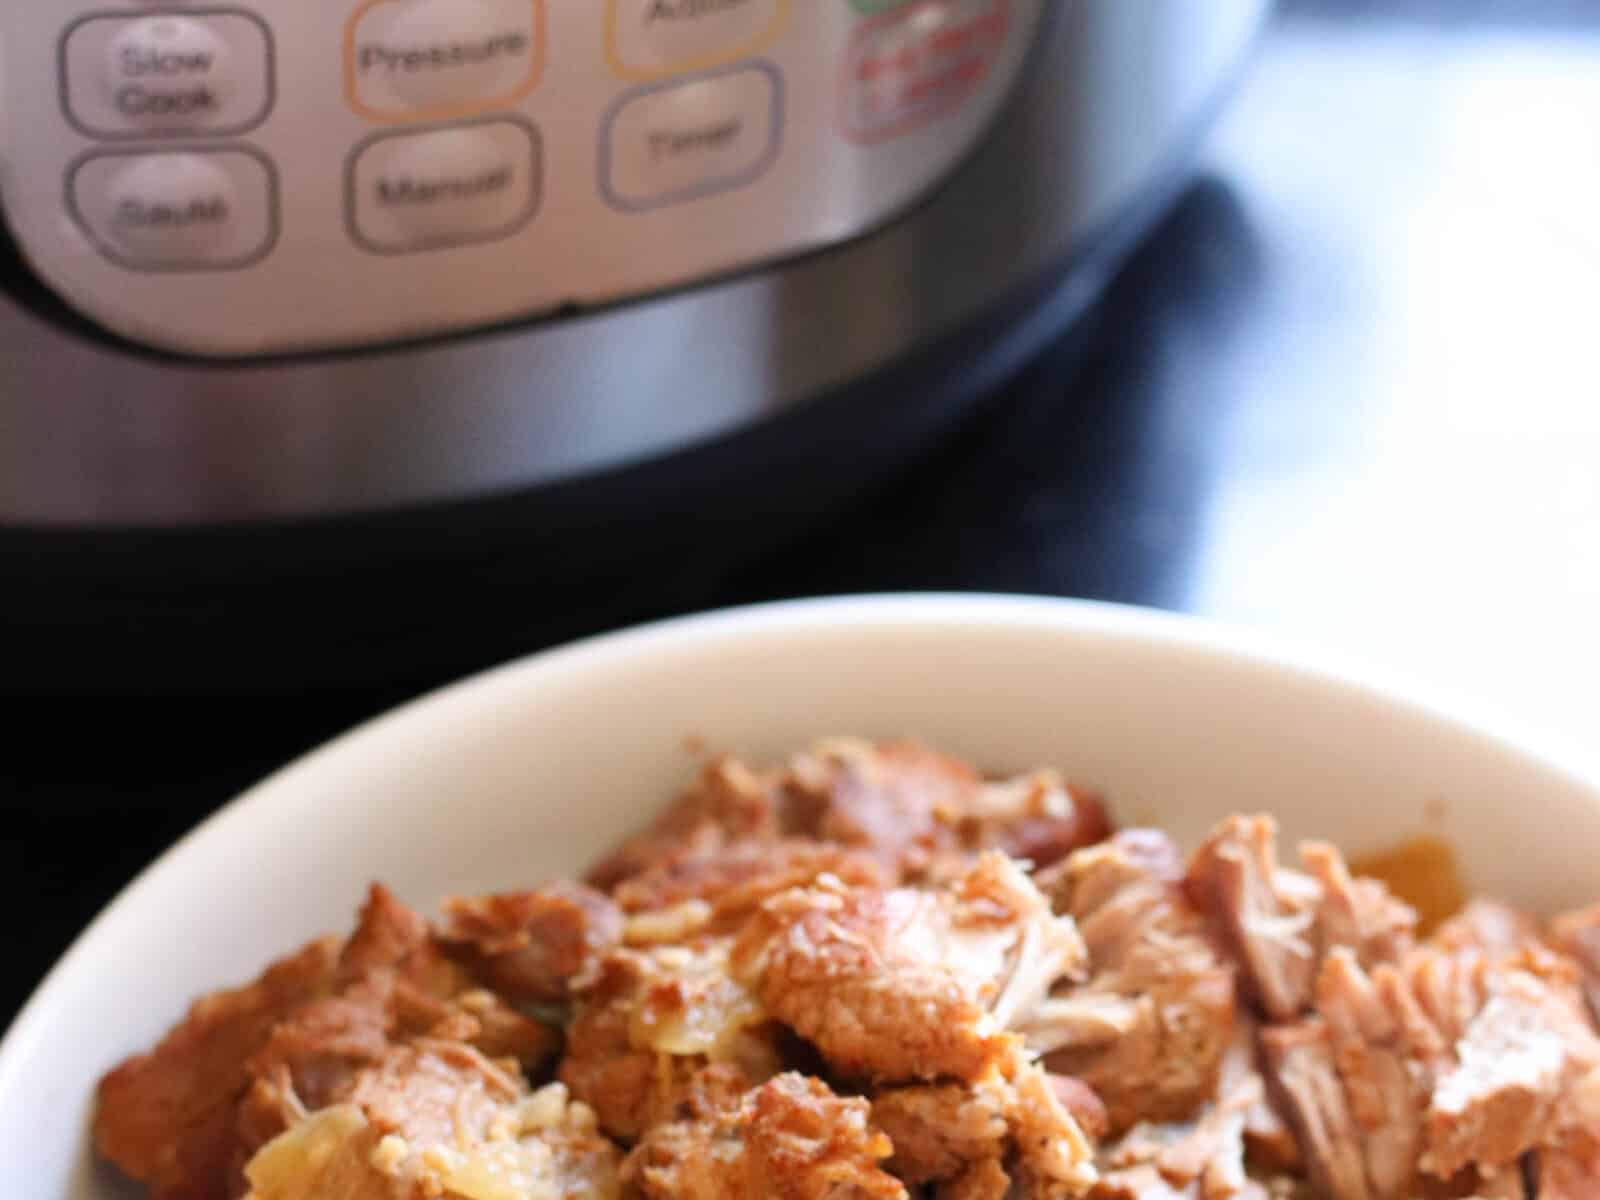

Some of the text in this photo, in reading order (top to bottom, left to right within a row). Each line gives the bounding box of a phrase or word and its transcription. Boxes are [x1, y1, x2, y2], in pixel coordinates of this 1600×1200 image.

[120, 47, 212, 76] Slow
[360, 35, 525, 72] Pressure
[116, 84, 217, 115] Cook
[648, 116, 742, 161] Timer
[376, 166, 512, 204] Manual
